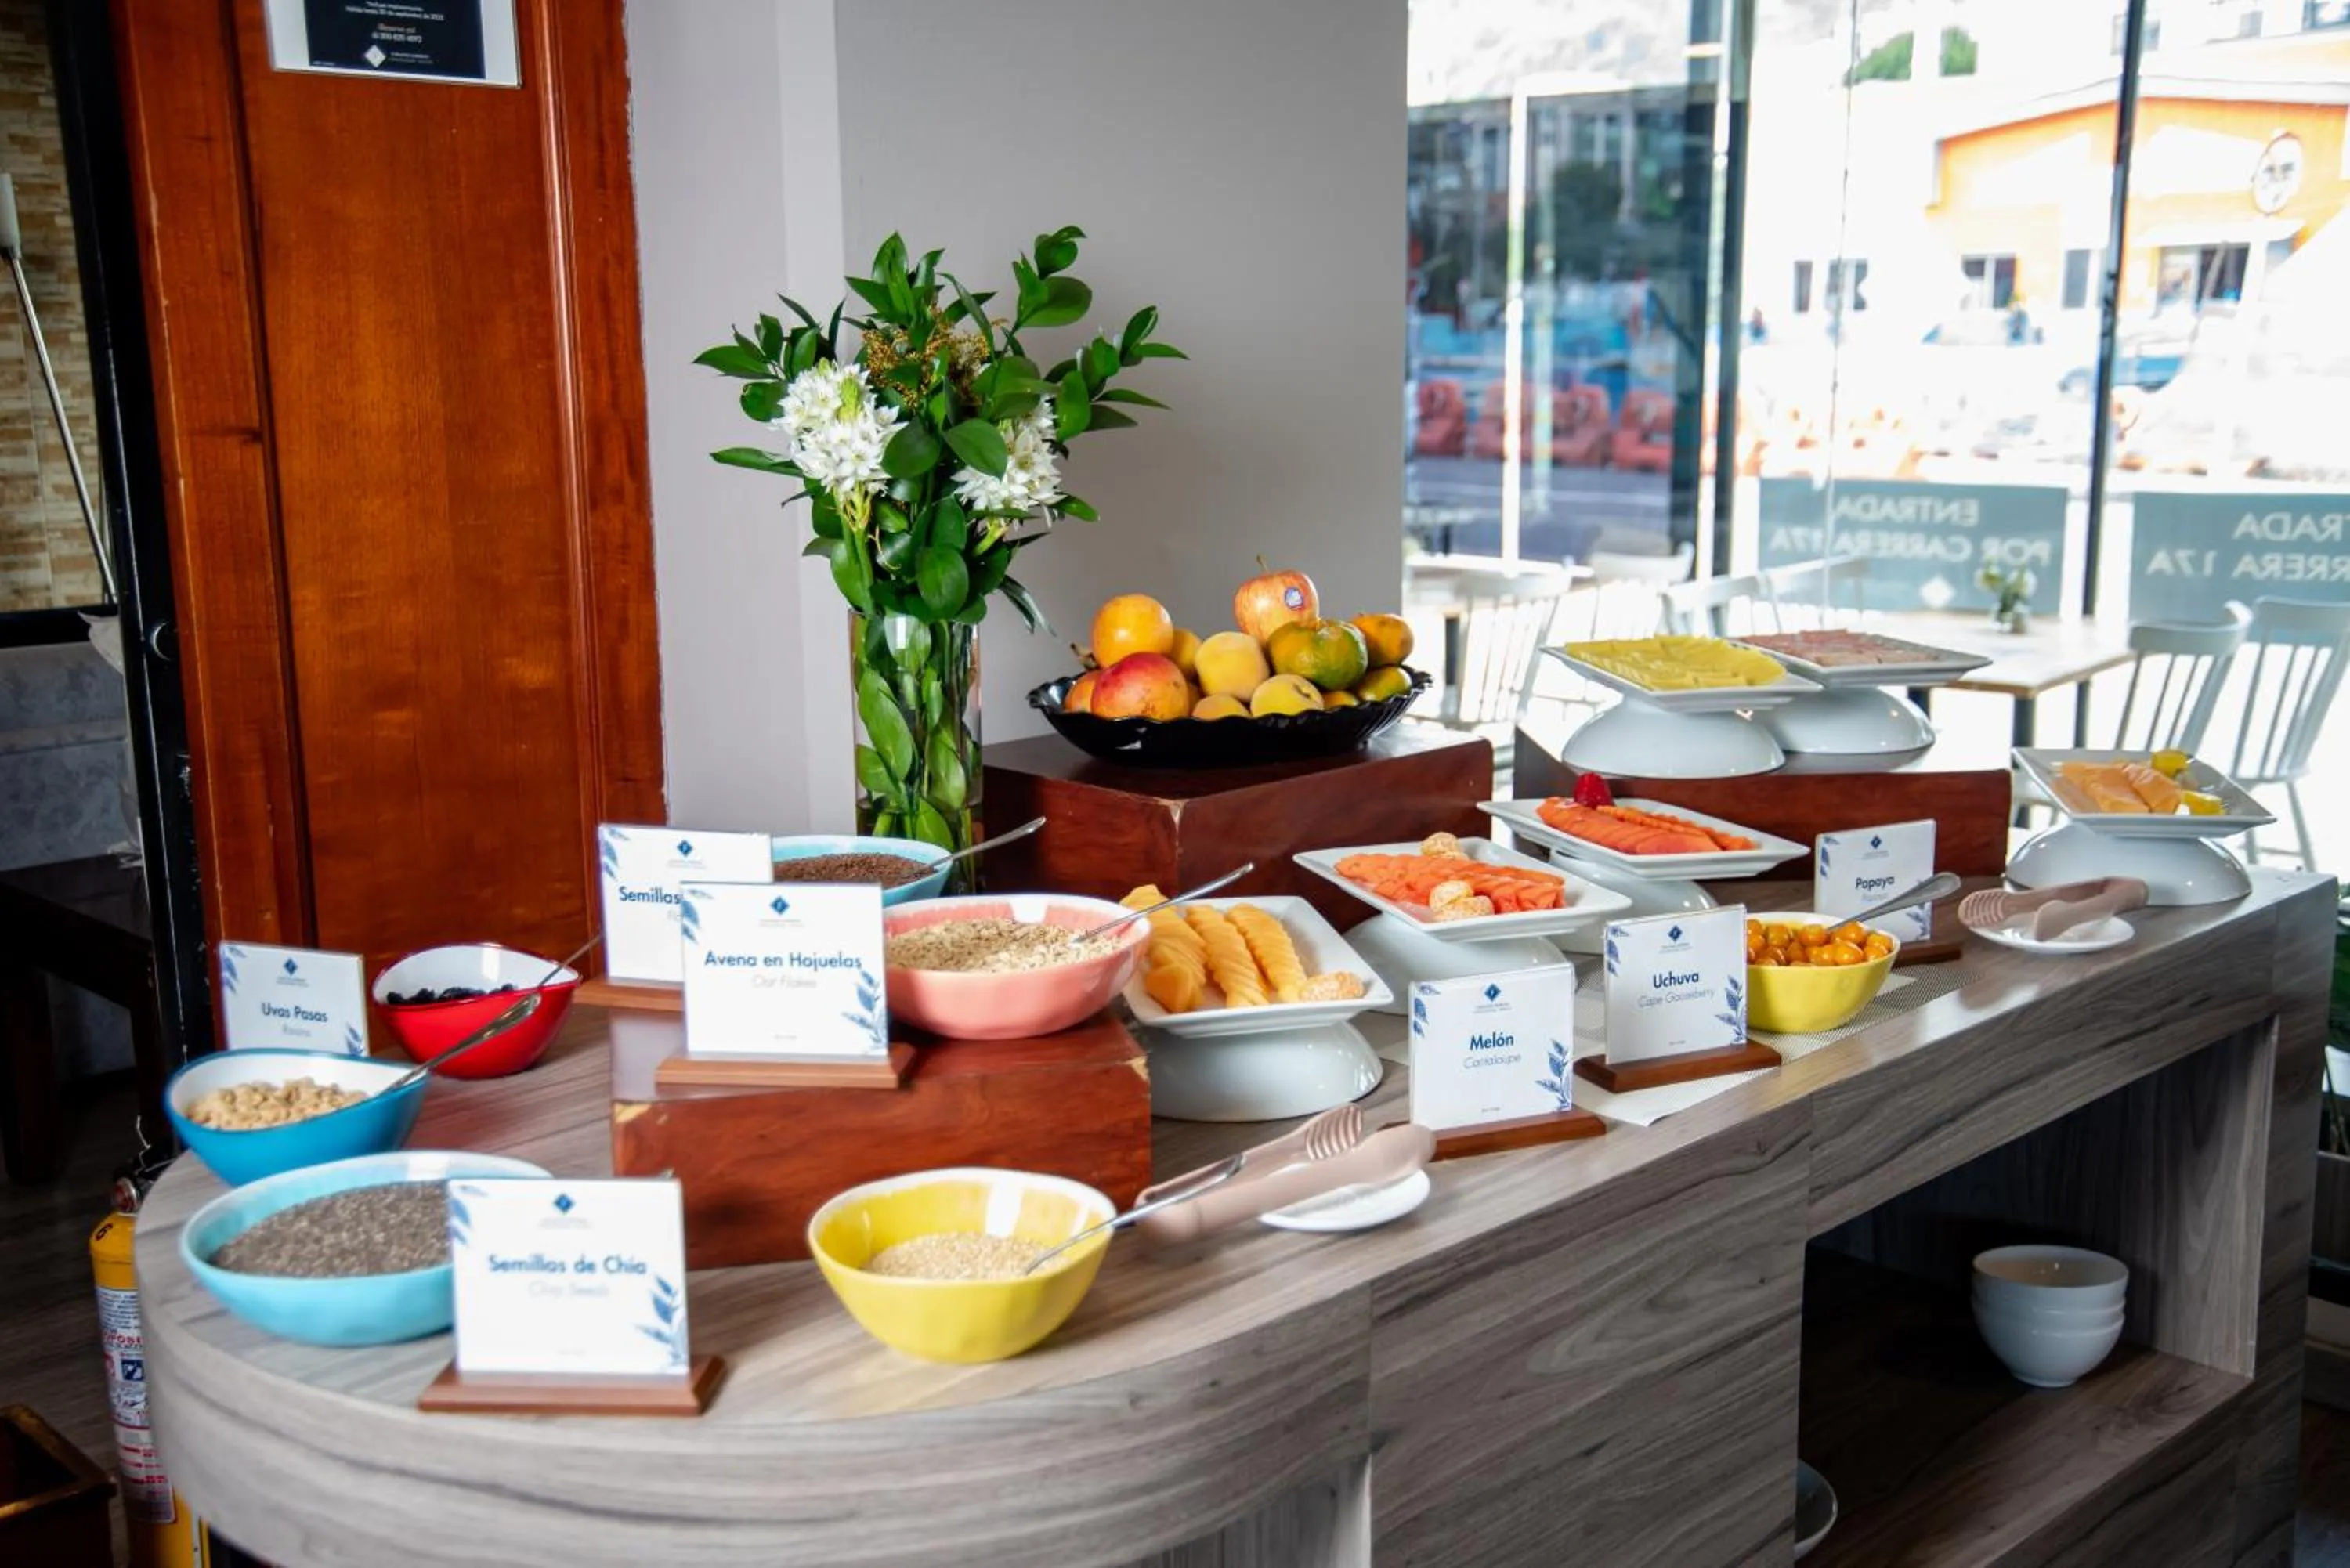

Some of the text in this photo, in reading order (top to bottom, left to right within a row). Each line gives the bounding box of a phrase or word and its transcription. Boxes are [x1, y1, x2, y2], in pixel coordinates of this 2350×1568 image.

[1855, 876, 1895, 891] Papaya
[619, 886, 682, 905] Semillas
[704, 951, 862, 971] Avena en Hojuelas
[1654, 971, 1699, 988] Uchuva
[262, 1003, 328, 1022] Uvas Pasas
[1470, 1031, 1514, 1050] Melón
[489, 1253, 566, 1273] Semillas
[574, 1254, 596, 1273] de
